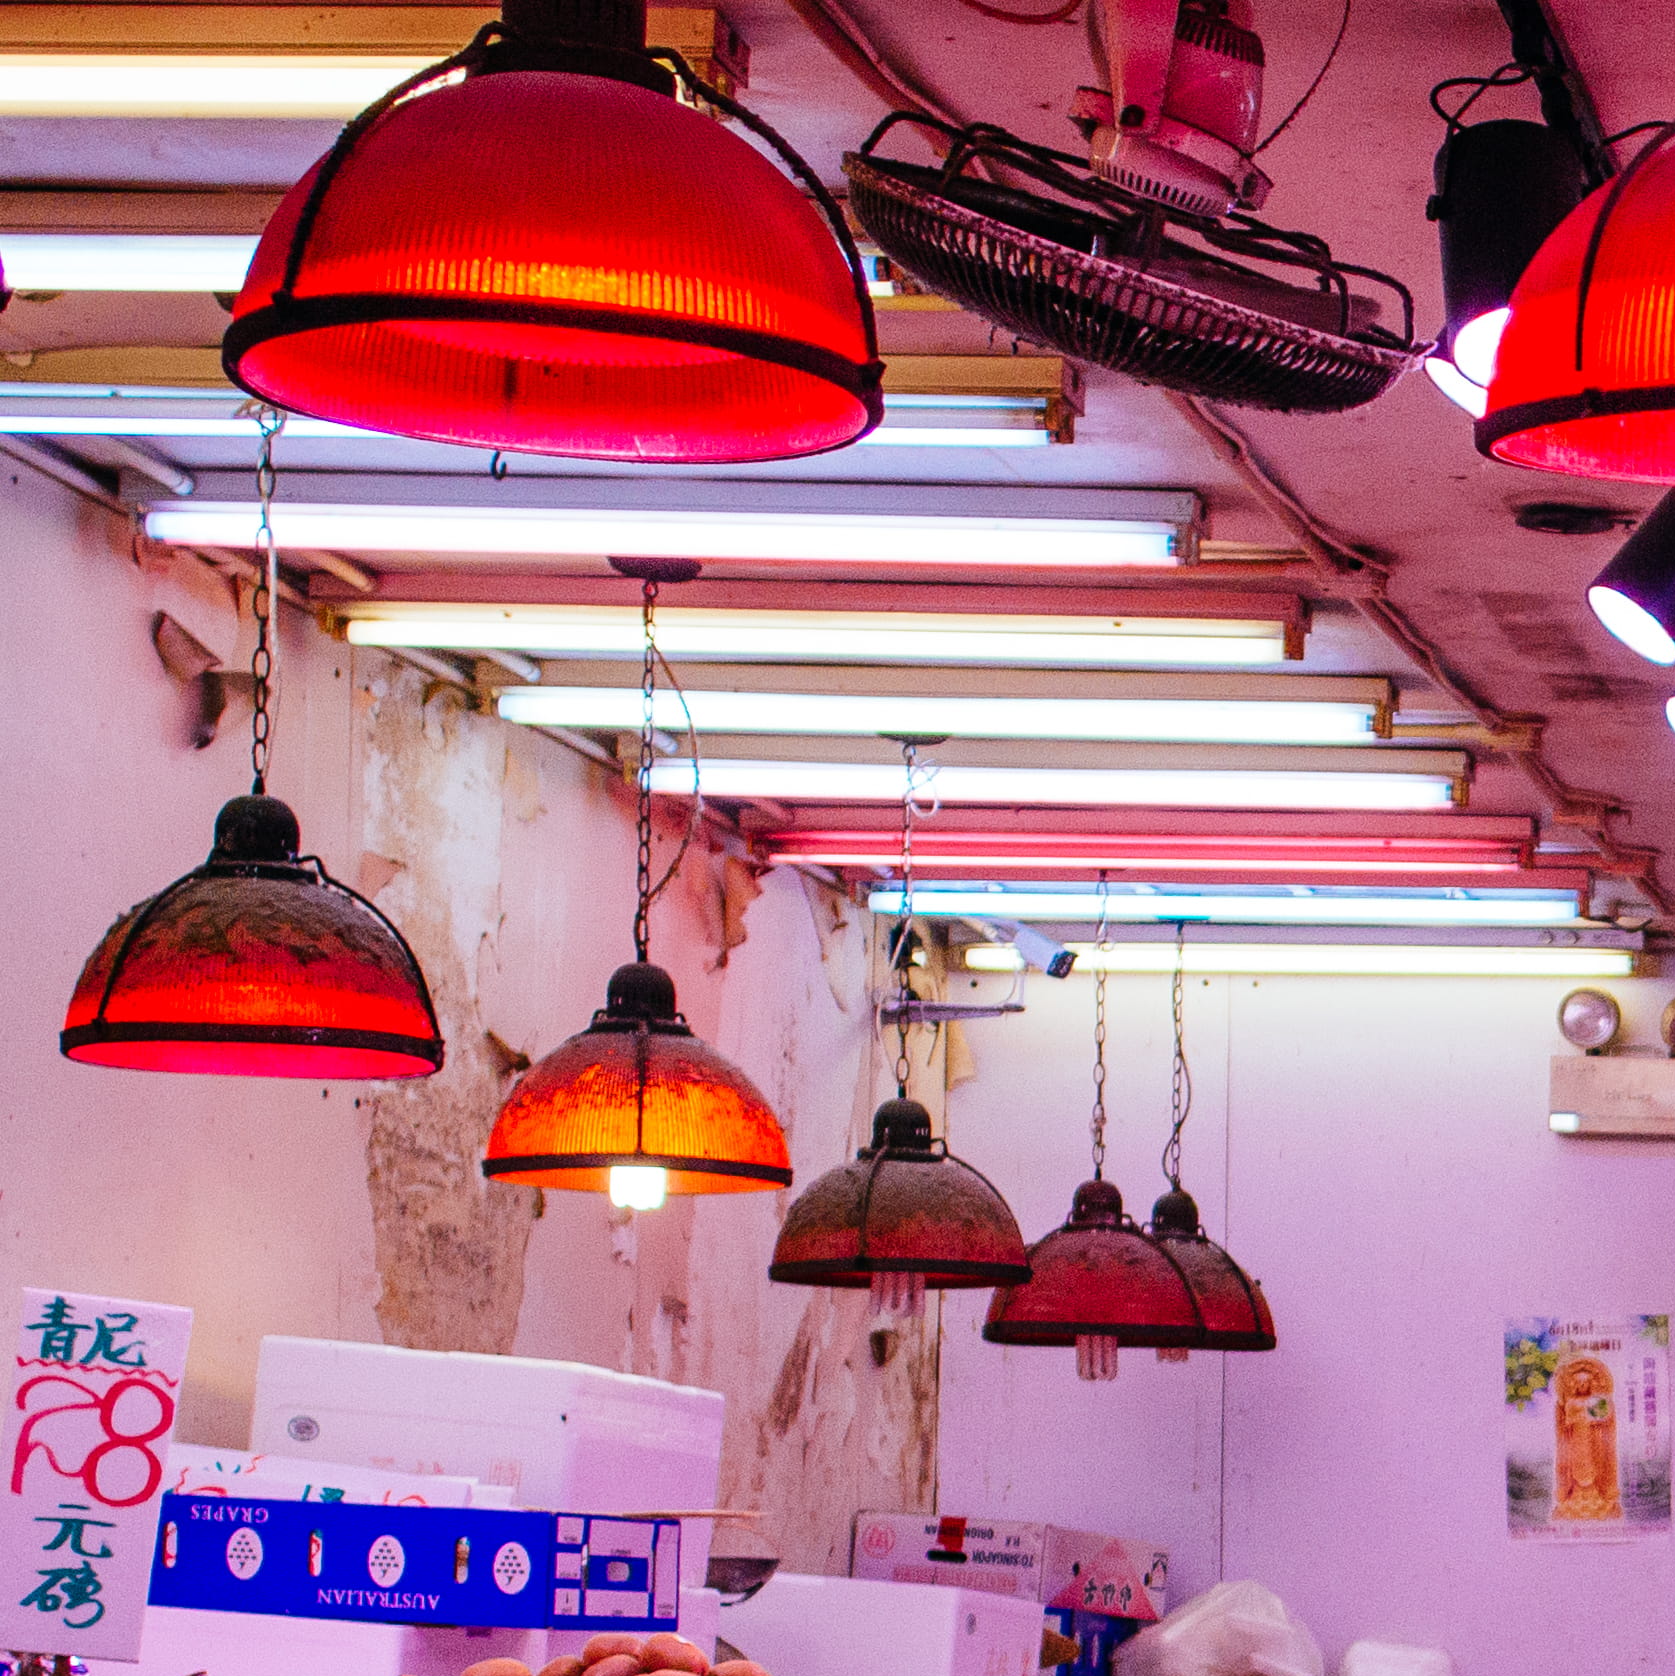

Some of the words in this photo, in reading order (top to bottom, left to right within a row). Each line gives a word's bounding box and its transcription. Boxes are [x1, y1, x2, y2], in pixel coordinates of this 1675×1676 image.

[26, 1294, 149, 1369] 青尼
[190, 1504, 269, 1523] GRAPES
[316, 1588, 440, 1611] AUSTRALIAN
